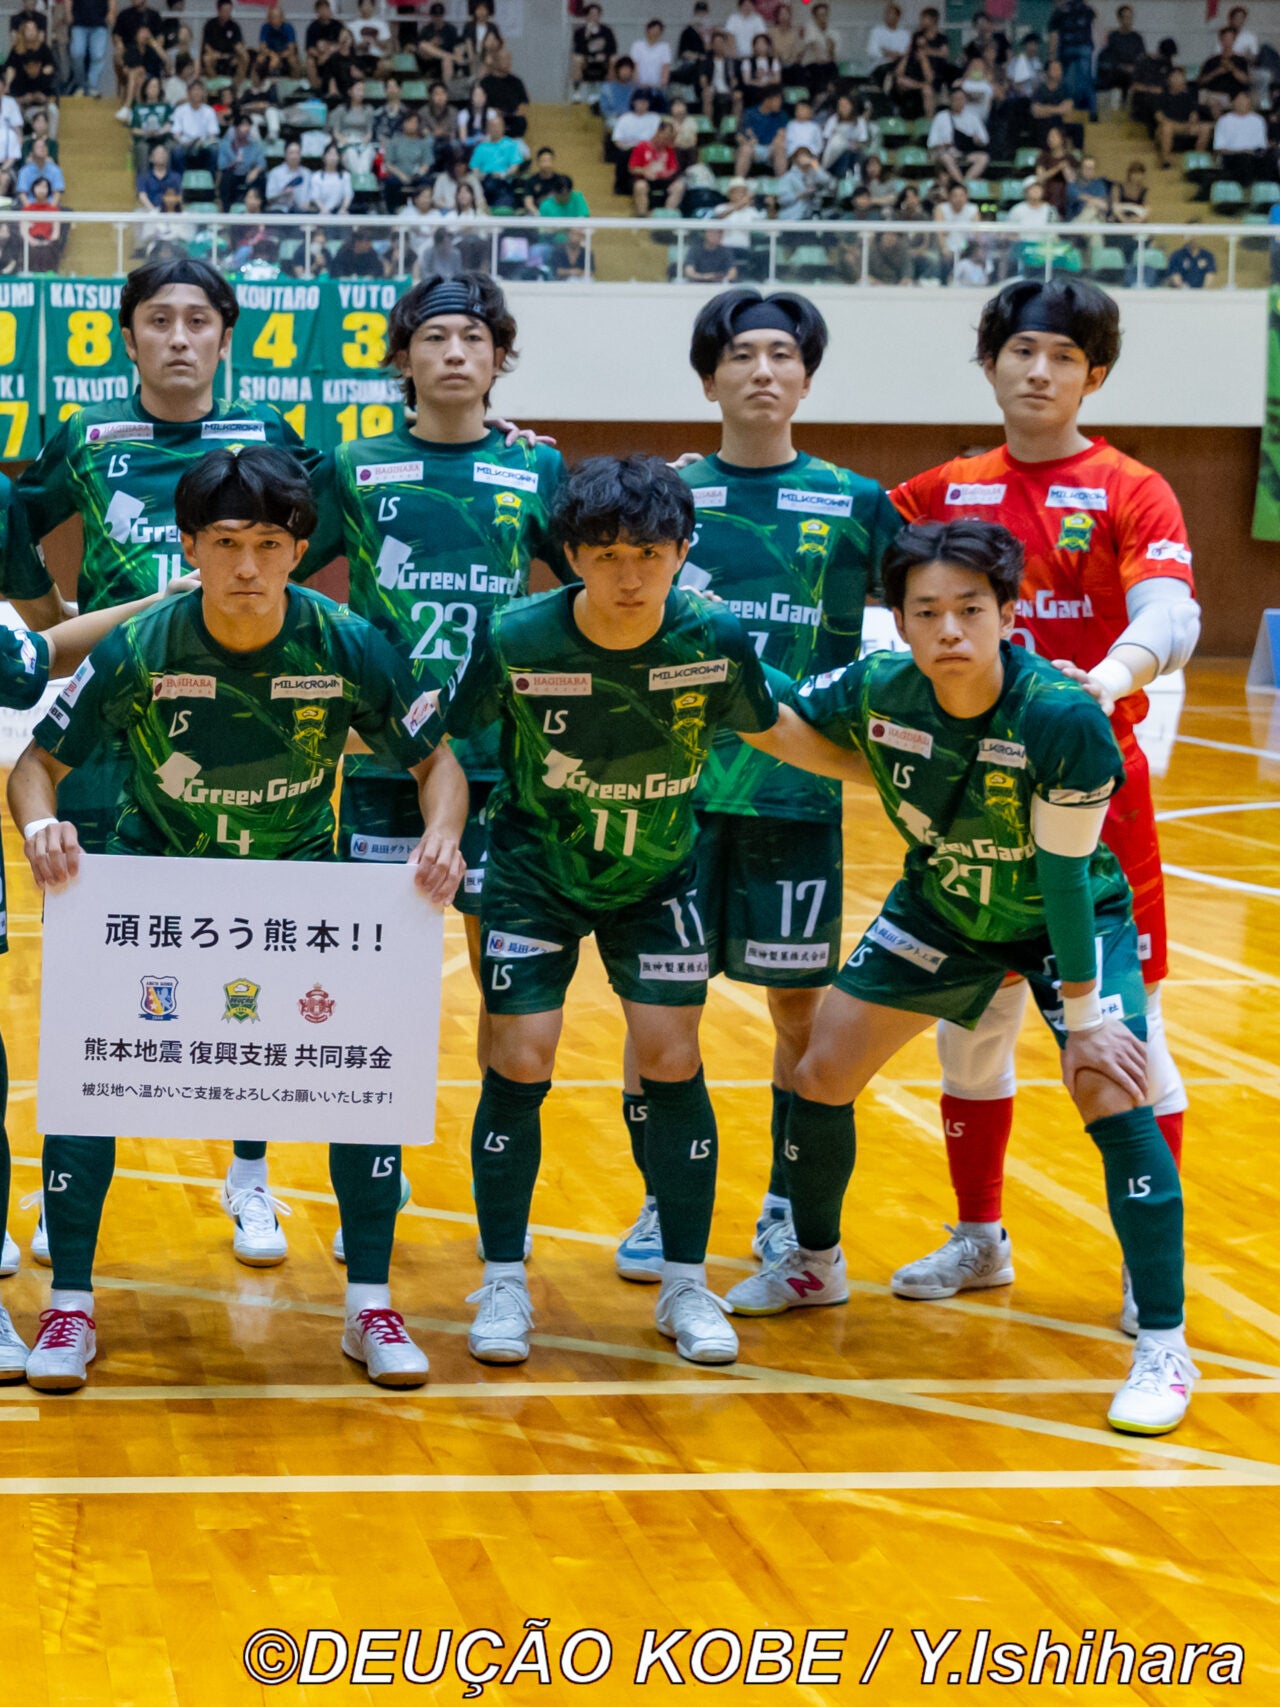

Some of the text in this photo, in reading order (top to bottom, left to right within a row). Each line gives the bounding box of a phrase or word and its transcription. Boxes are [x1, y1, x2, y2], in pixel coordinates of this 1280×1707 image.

[236, 284, 320, 311] KOUTARO
[338, 284, 396, 309] YUTO
[67, 310, 113, 367] 8
[252, 312, 297, 368] 4
[342, 311, 388, 369] 3
[53, 375, 129, 402] TAKUTO
[239, 376, 313, 401] SHOMA
[780, 493, 851, 509] MILKCROWN
[470, 564, 519, 595] Gard
[770, 593, 822, 627] Gard
[409, 601, 478, 661] 23
[273, 678, 341, 690] MILKCROWN
[533, 677, 588, 686] HAGIHARA
[652, 663, 726, 681] MILKCROWN
[267, 768, 324, 803] Gard
[645, 763, 702, 799] Gard
[216, 814, 254, 855] 4
[590, 808, 639, 857] 11
[928, 856, 992, 905] 27
[776, 880, 827, 938] 17
[641, 961, 709, 974] 阪神製菓株式
[84, 1037, 393, 1070] 熊本地震 復興支援 共同募金
